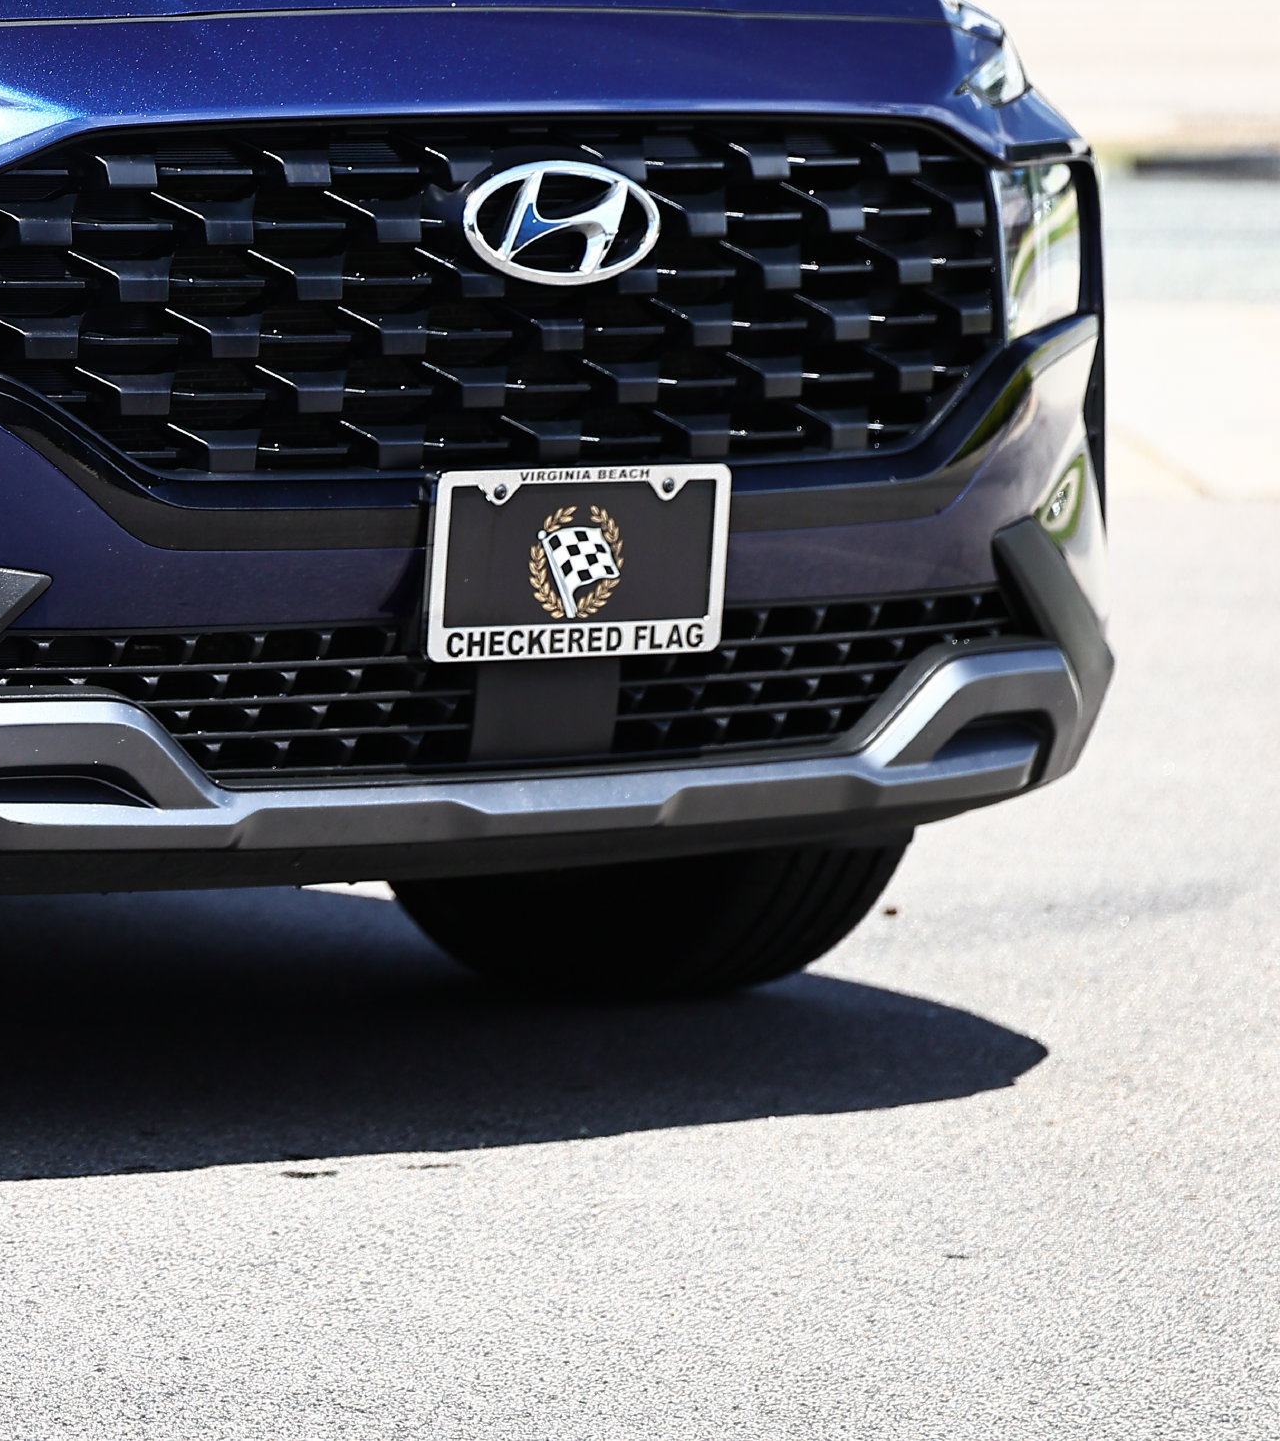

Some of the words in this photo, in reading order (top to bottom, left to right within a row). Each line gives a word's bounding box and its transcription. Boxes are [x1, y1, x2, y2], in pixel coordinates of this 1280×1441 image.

[520, 469, 591, 482] VIRGINIA
[597, 468, 651, 480] BEACH
[446, 626, 622, 658] CHECKERED
[633, 623, 704, 651] FLAG
